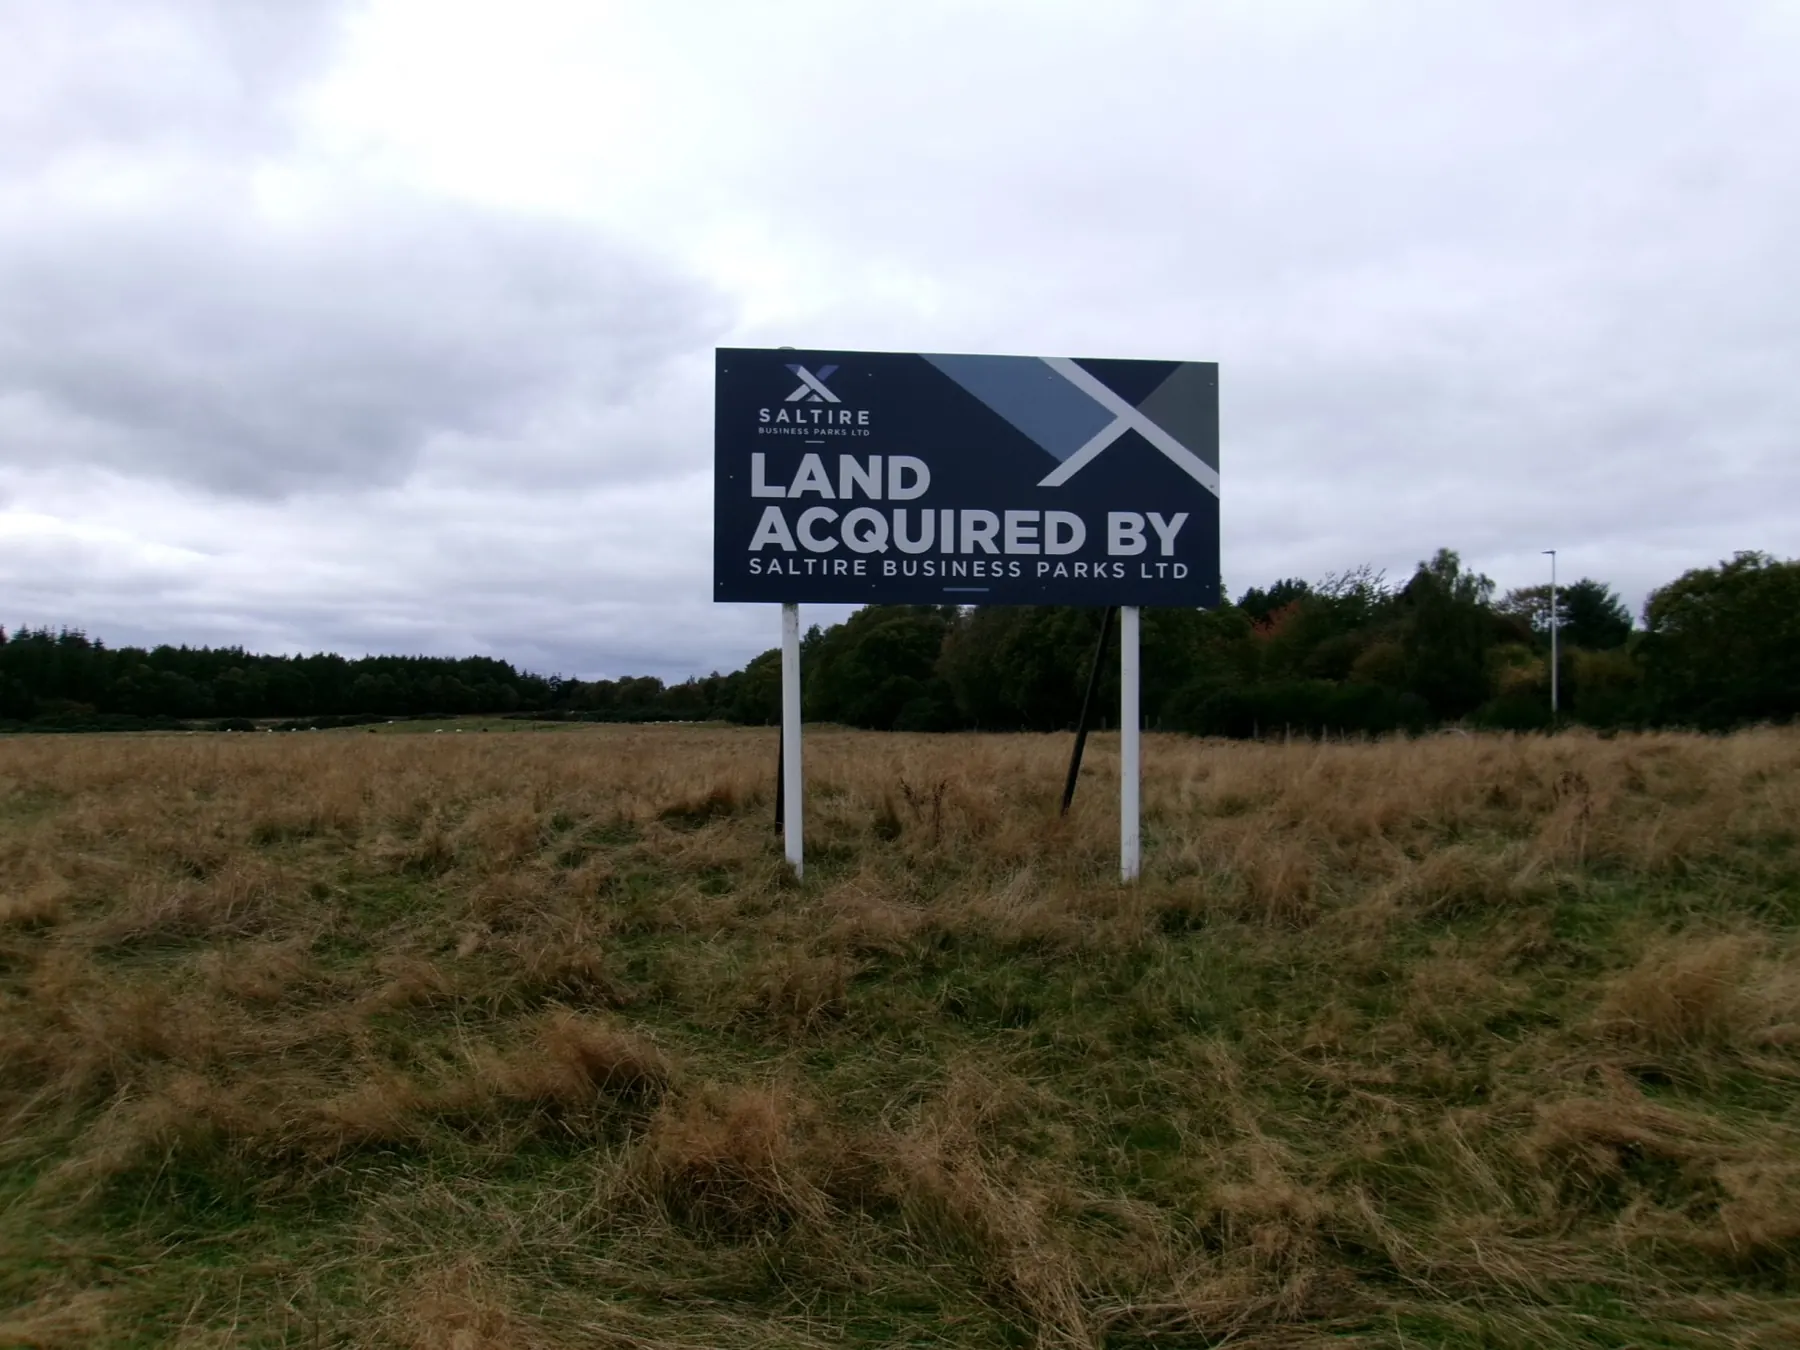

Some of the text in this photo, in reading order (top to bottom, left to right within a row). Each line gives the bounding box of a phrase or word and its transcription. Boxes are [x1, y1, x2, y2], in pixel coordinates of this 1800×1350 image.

[759, 408, 869, 425] SALTIRE
[758, 427, 870, 437] BUSINESS PARKS LTD
[751, 452, 931, 500] LAND
[748, 506, 1189, 556] ACQUIRED BY
[749, 558, 1189, 579] SALTIRE BUSINESS PARKS LTD
